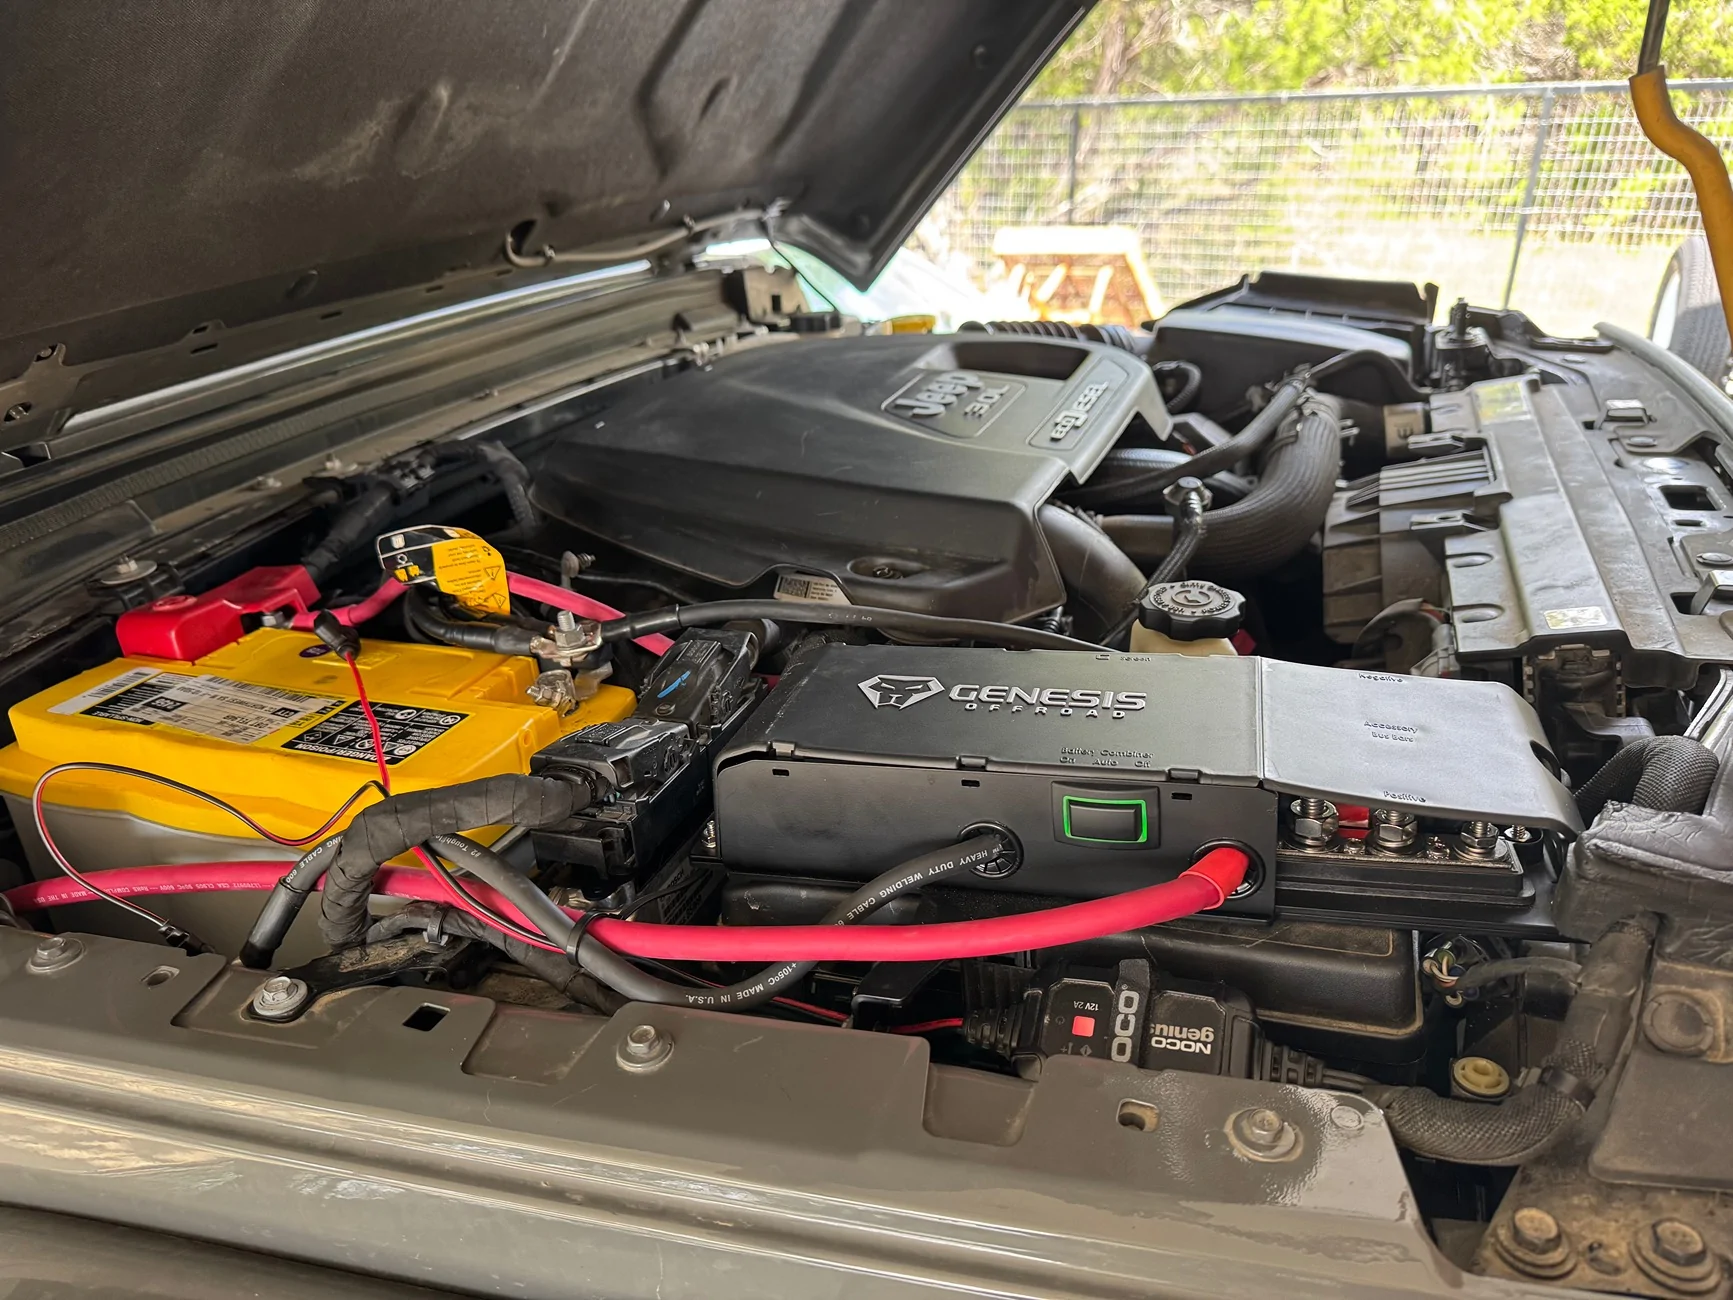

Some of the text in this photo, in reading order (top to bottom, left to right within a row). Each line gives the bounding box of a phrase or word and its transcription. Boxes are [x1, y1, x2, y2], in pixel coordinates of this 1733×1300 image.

[894, 371, 984, 416] Jeep
[949, 684, 1147, 710] GENESIS
[964, 703, 1126, 719] OFFROAD
[1364, 720, 1418, 734] Accessory
[1371, 731, 1414, 743] Bus Bars
[1100, 748, 1154, 759] Combiner
[1059, 756, 1076, 764] On
[1092, 758, 1119, 767] Auto
[1384, 790, 1427, 803] Positive
[299, 847, 323, 869] CABLE
[286, 868, 298, 883] 600
[846, 849, 989, 921] HEAVY DUTY WELDING CABLE
[720, 994, 732, 1004] IN
[736, 982, 765, 1001] MADE
[1073, 1000, 1100, 1012] 12V 2A
[1110, 990, 1140, 1063] OCO
[1151, 1037, 1212, 1055] NOCO
